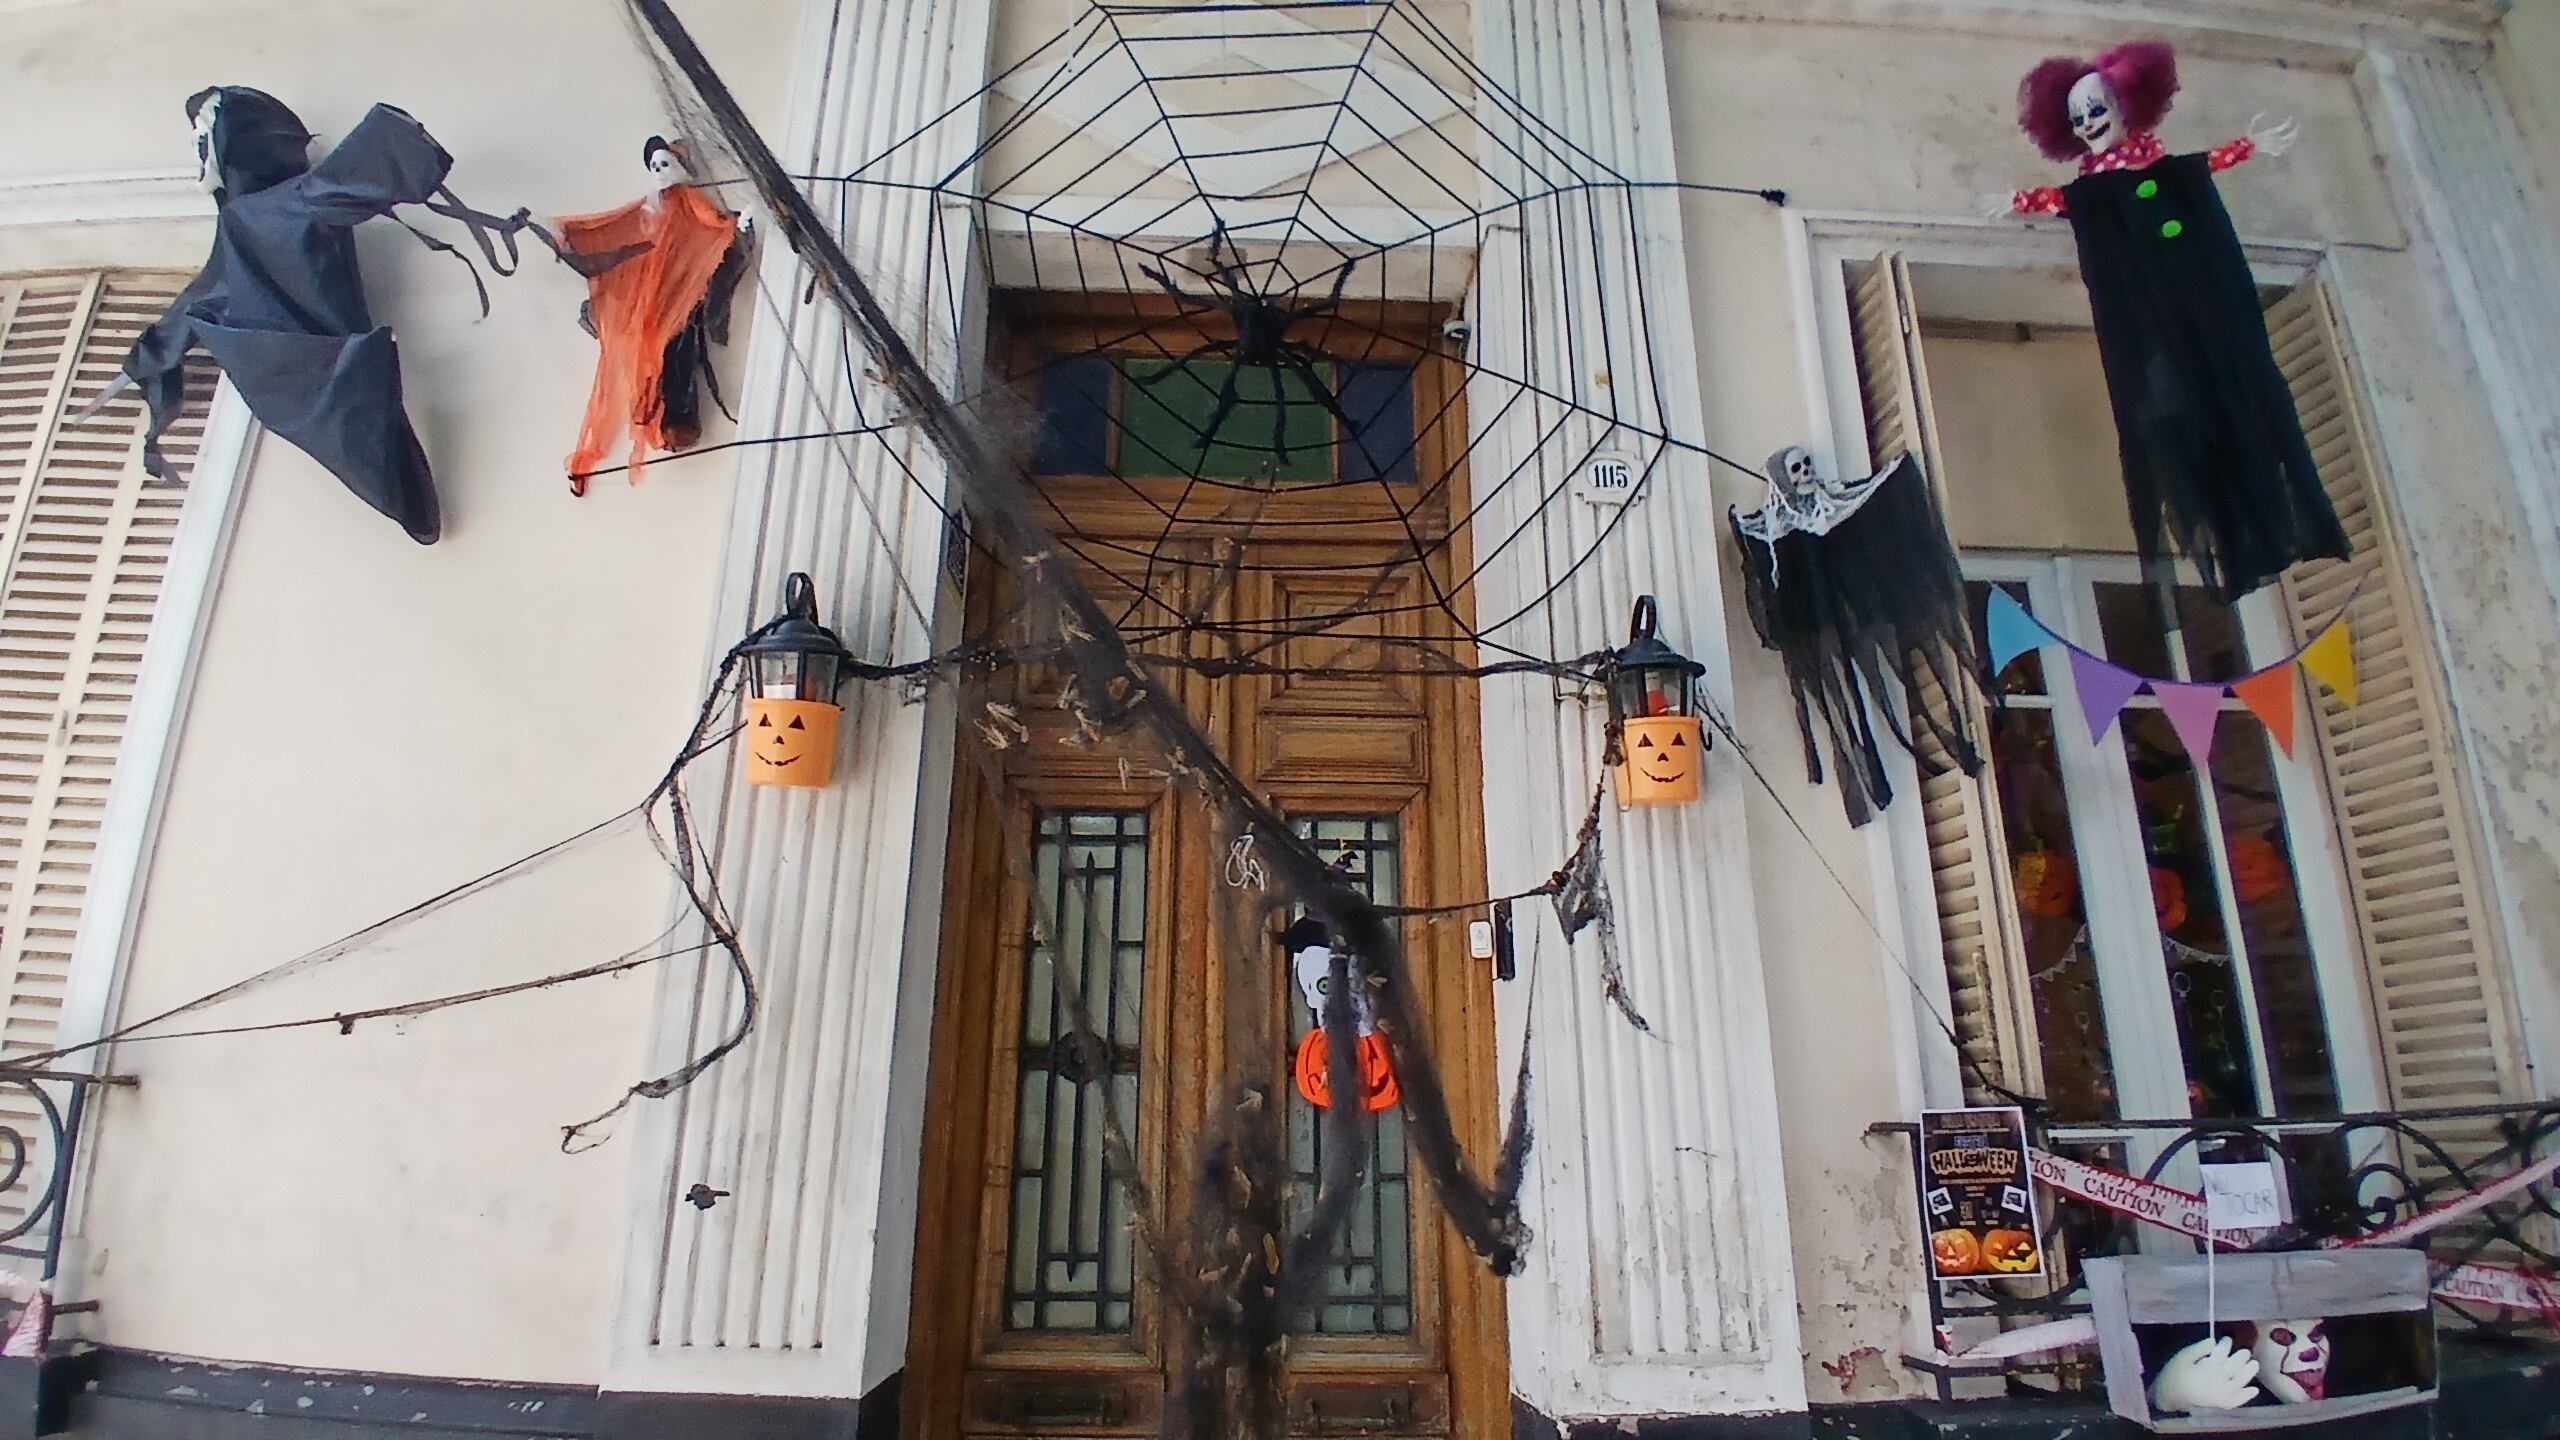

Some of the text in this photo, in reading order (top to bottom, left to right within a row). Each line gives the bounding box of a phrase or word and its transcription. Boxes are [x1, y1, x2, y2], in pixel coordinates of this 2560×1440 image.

[1594, 464, 1628, 488] 1115
[1930, 1148, 2018, 1174] HALLOWEEN
[2028, 1156, 2066, 1183] ION
[2083, 1177, 2165, 1218] CAUTION
[2444, 1278, 2504, 1299] CAUTION
